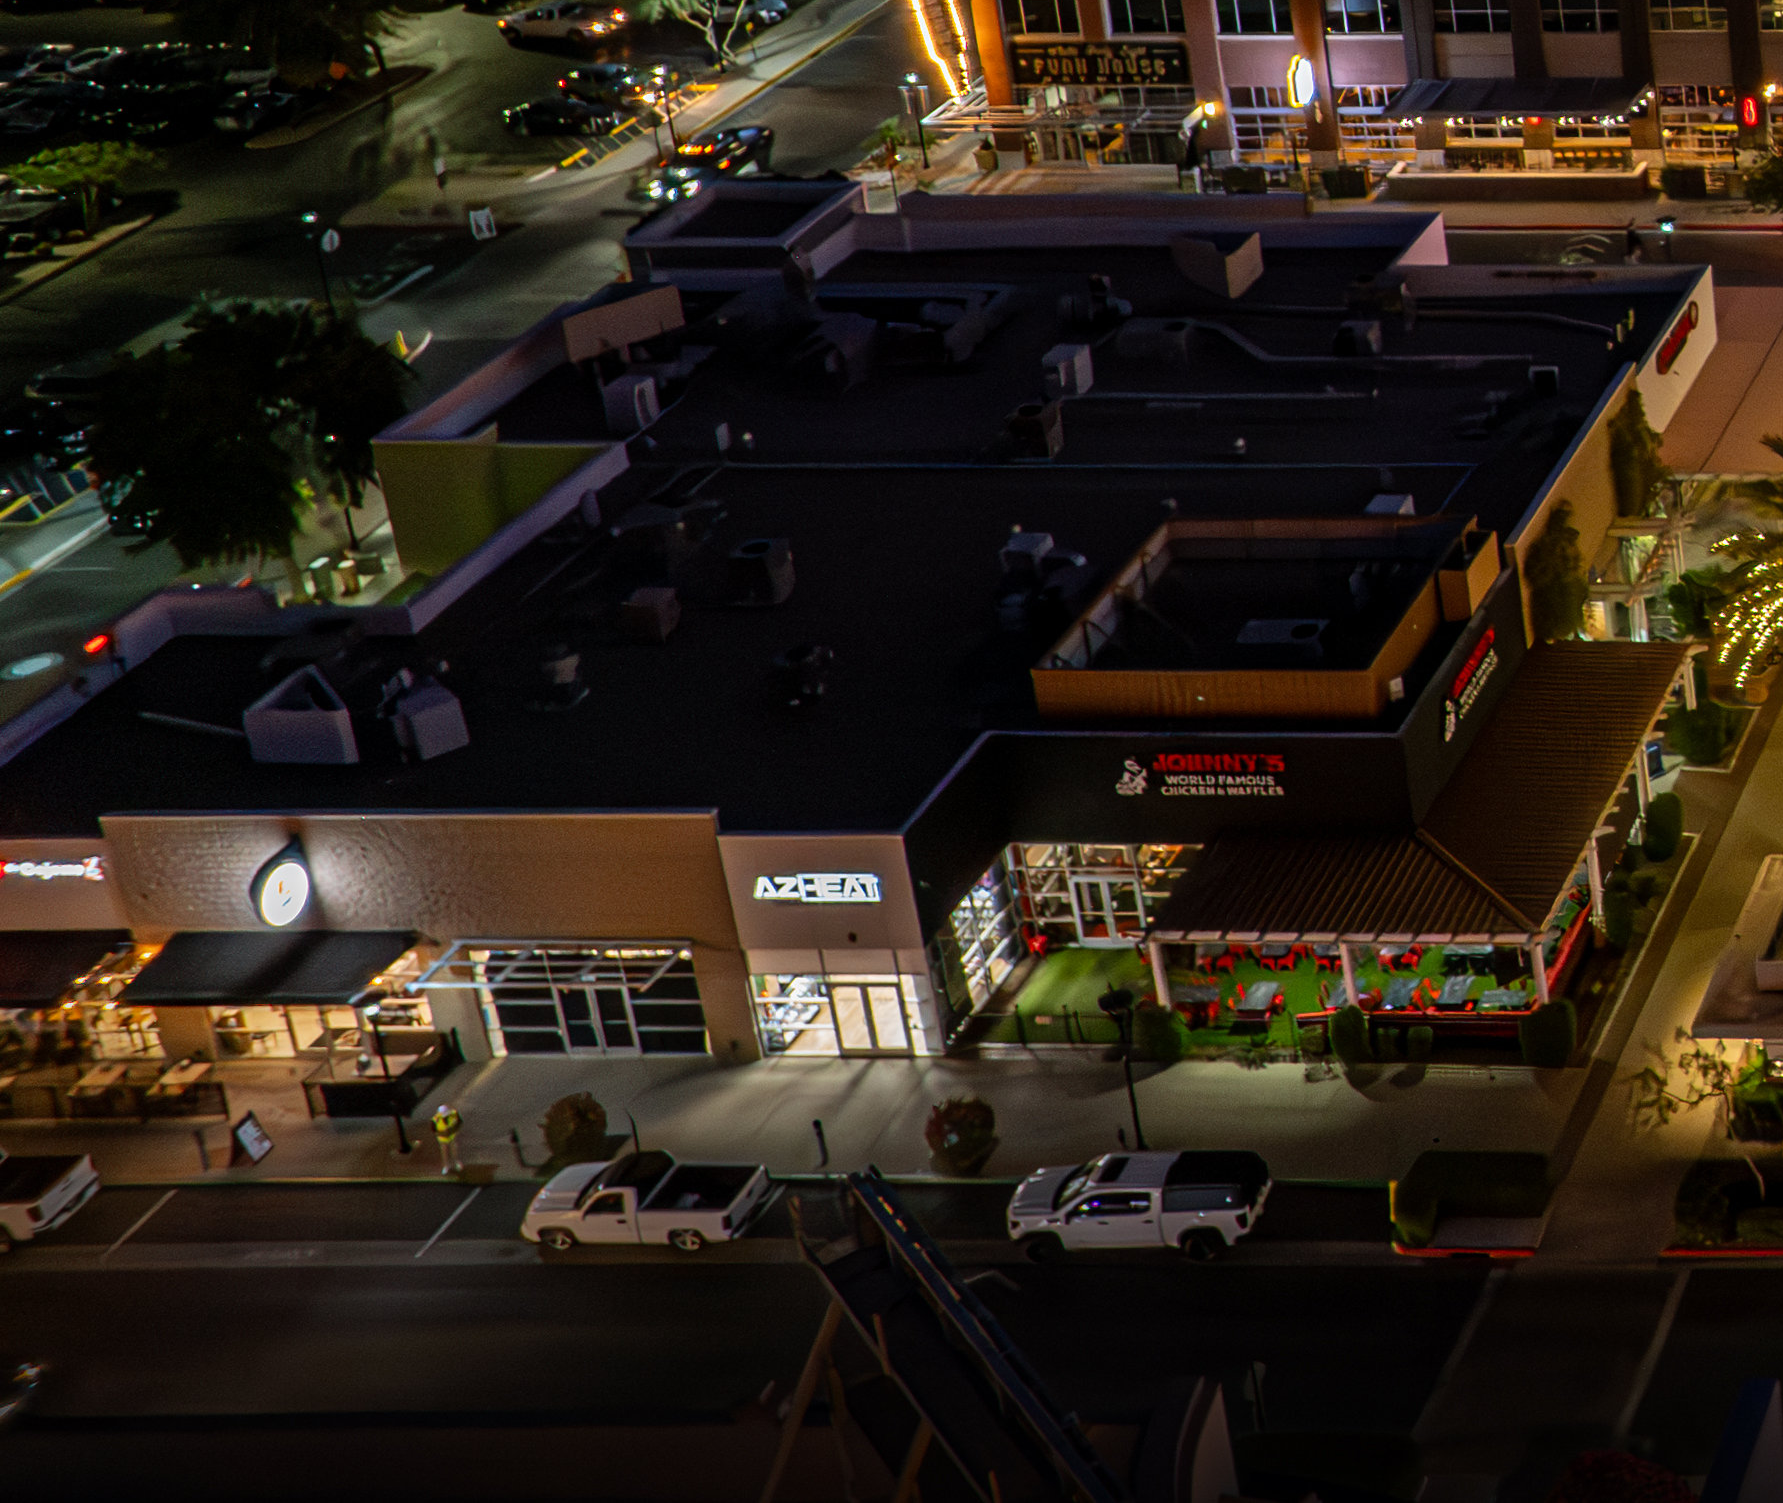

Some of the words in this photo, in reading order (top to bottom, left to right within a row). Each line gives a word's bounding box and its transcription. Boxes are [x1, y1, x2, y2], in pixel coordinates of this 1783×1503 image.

[1153, 754, 1285, 772] JOHNNY'S
[1164, 774, 1216, 786] WORLD
[1218, 774, 1275, 786] FAMOUS
[1160, 785, 1215, 796] CHICKEN
[1227, 785, 1285, 796] WAFFLES
